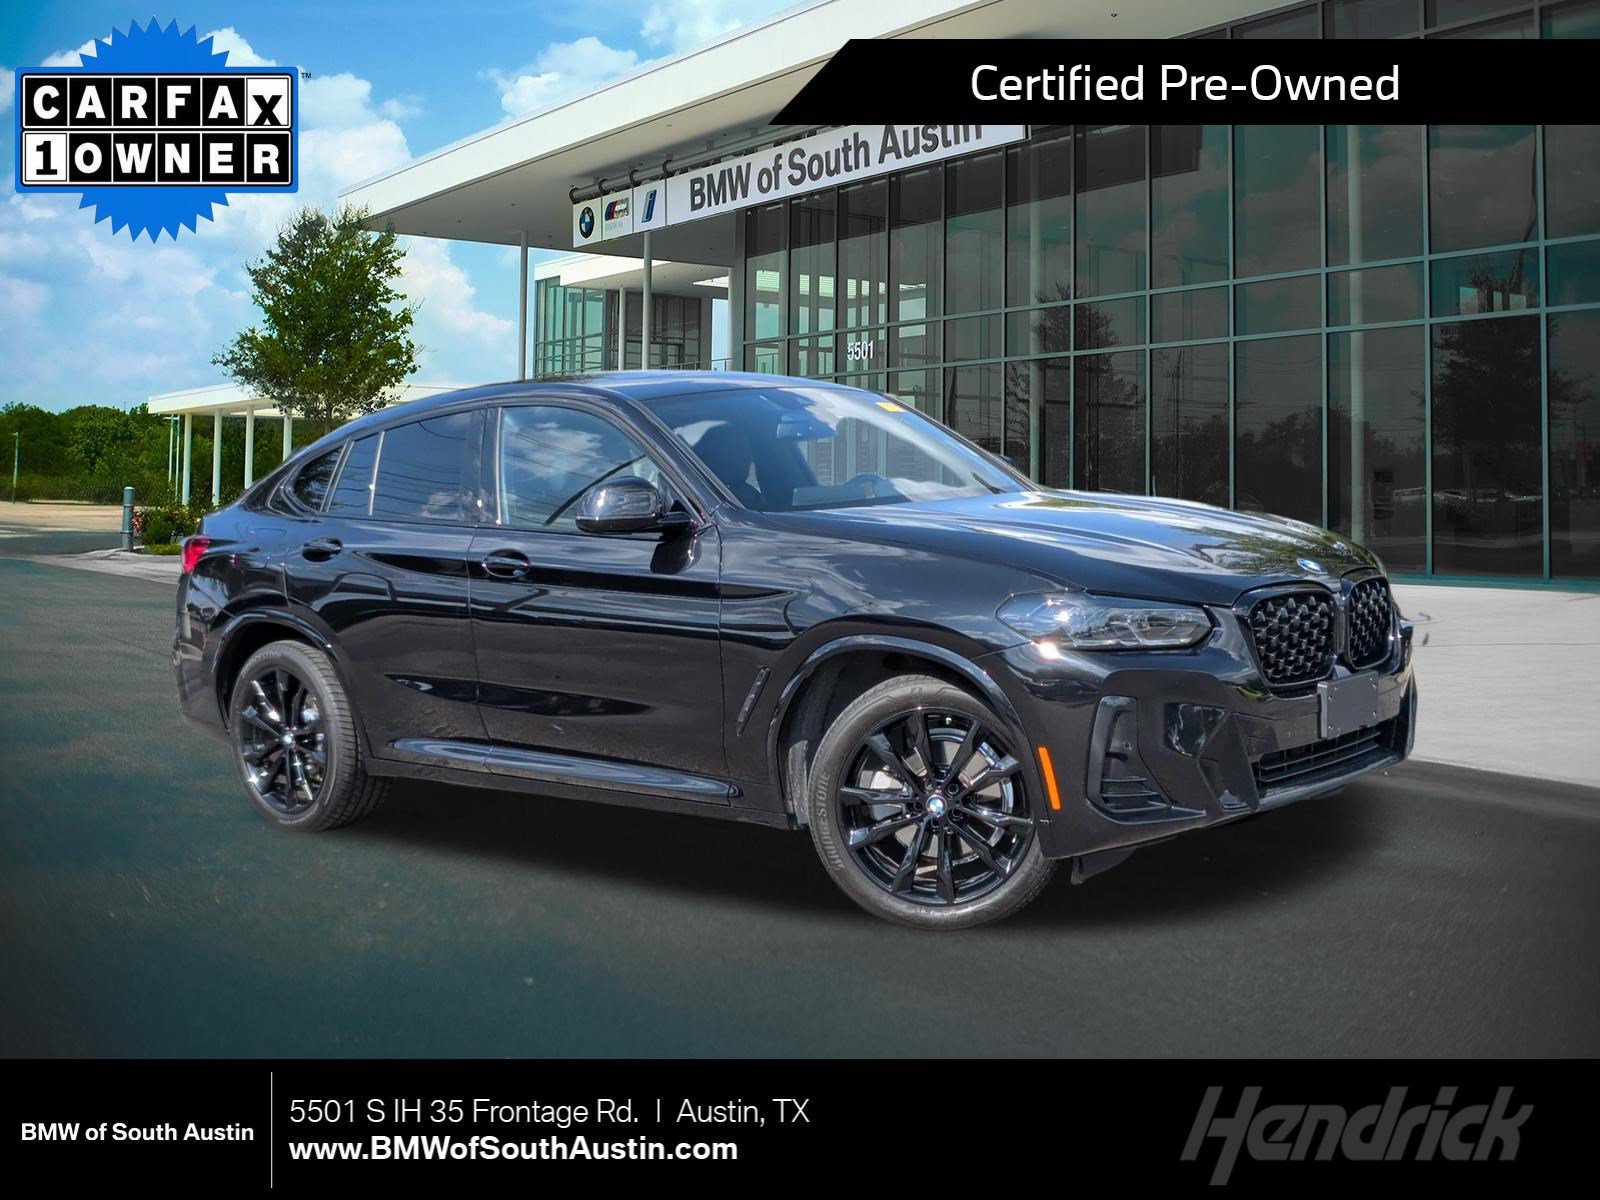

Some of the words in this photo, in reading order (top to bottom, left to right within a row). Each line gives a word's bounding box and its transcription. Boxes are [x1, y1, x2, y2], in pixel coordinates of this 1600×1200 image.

[690, 162, 752, 212] BMW
[757, 153, 783, 194] of
[787, 131, 871, 187] South
[847, 340, 874, 361] 5501
